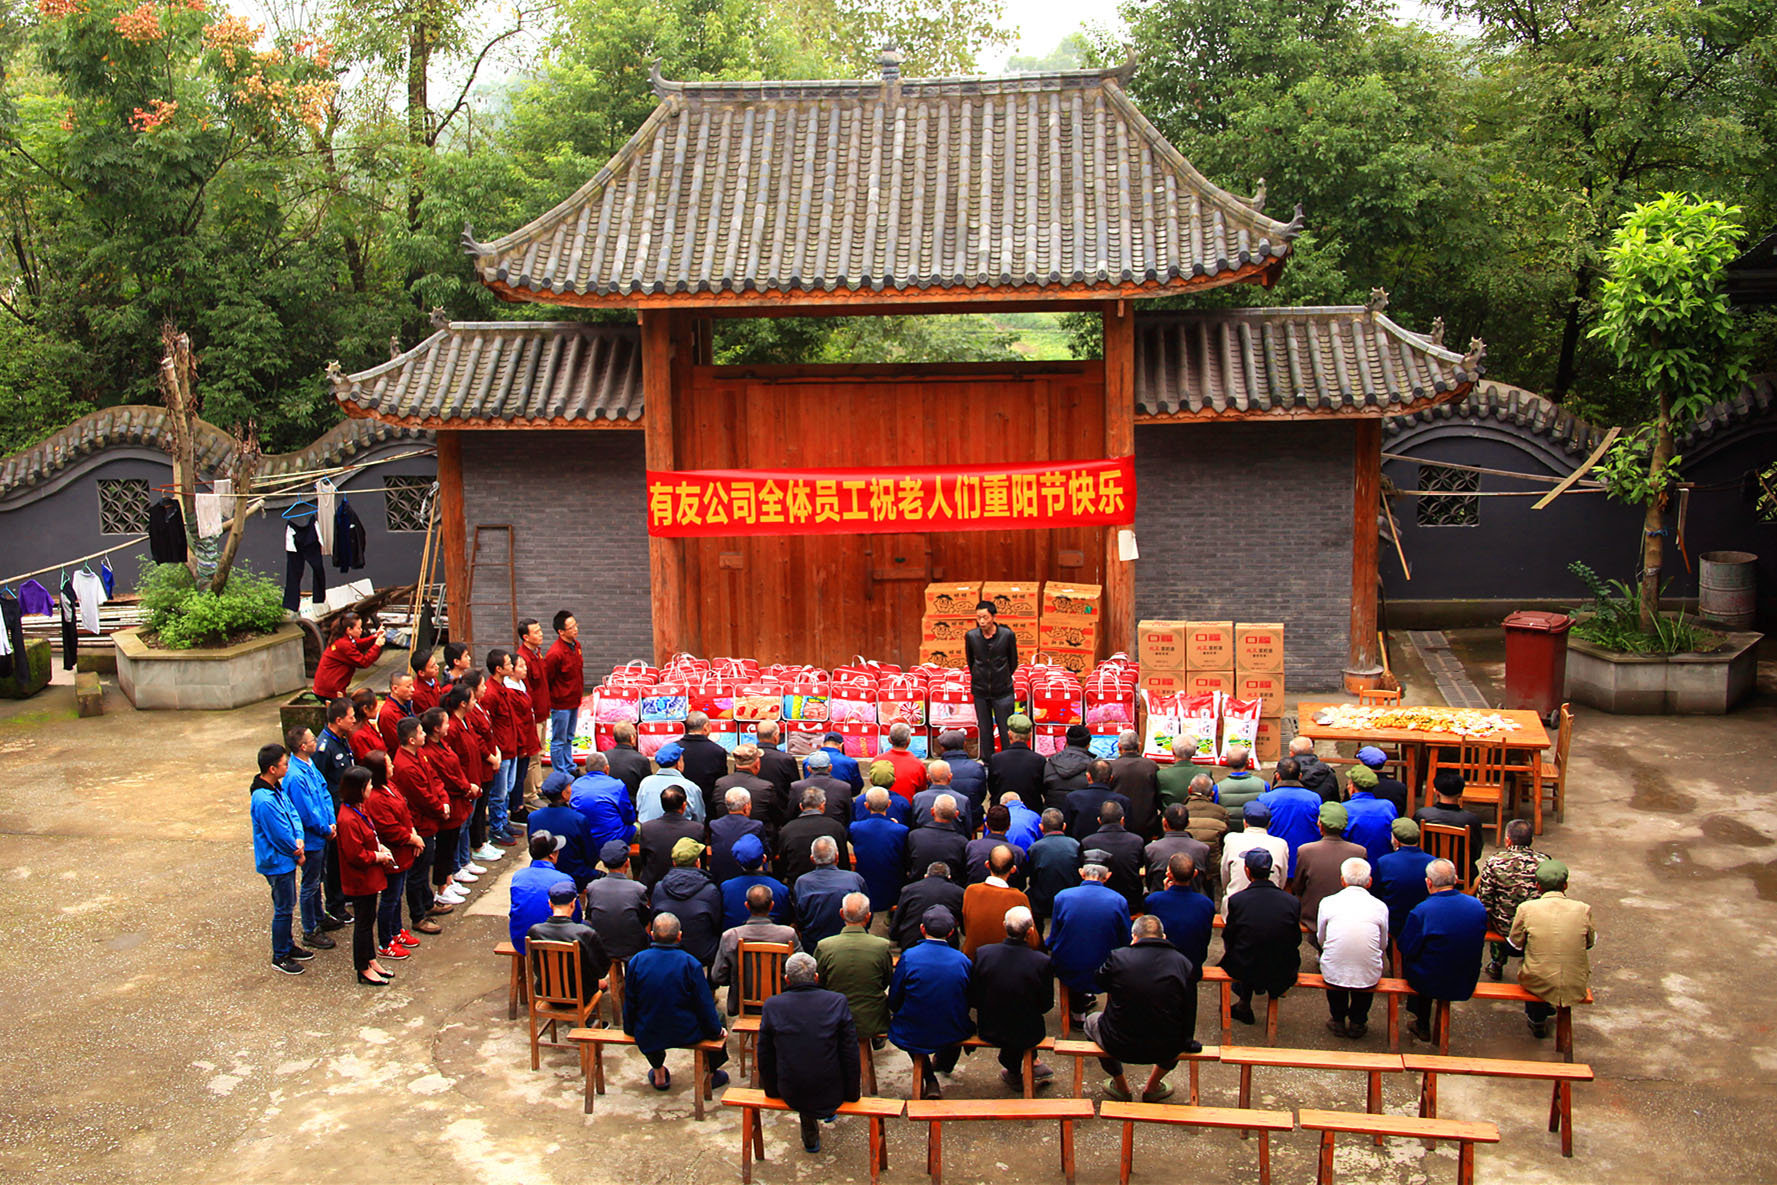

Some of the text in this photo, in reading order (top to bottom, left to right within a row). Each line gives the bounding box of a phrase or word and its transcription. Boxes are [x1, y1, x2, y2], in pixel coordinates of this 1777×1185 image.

[650, 470, 1125, 526] 有友公司全体员工祝老人们重阳节快乐
